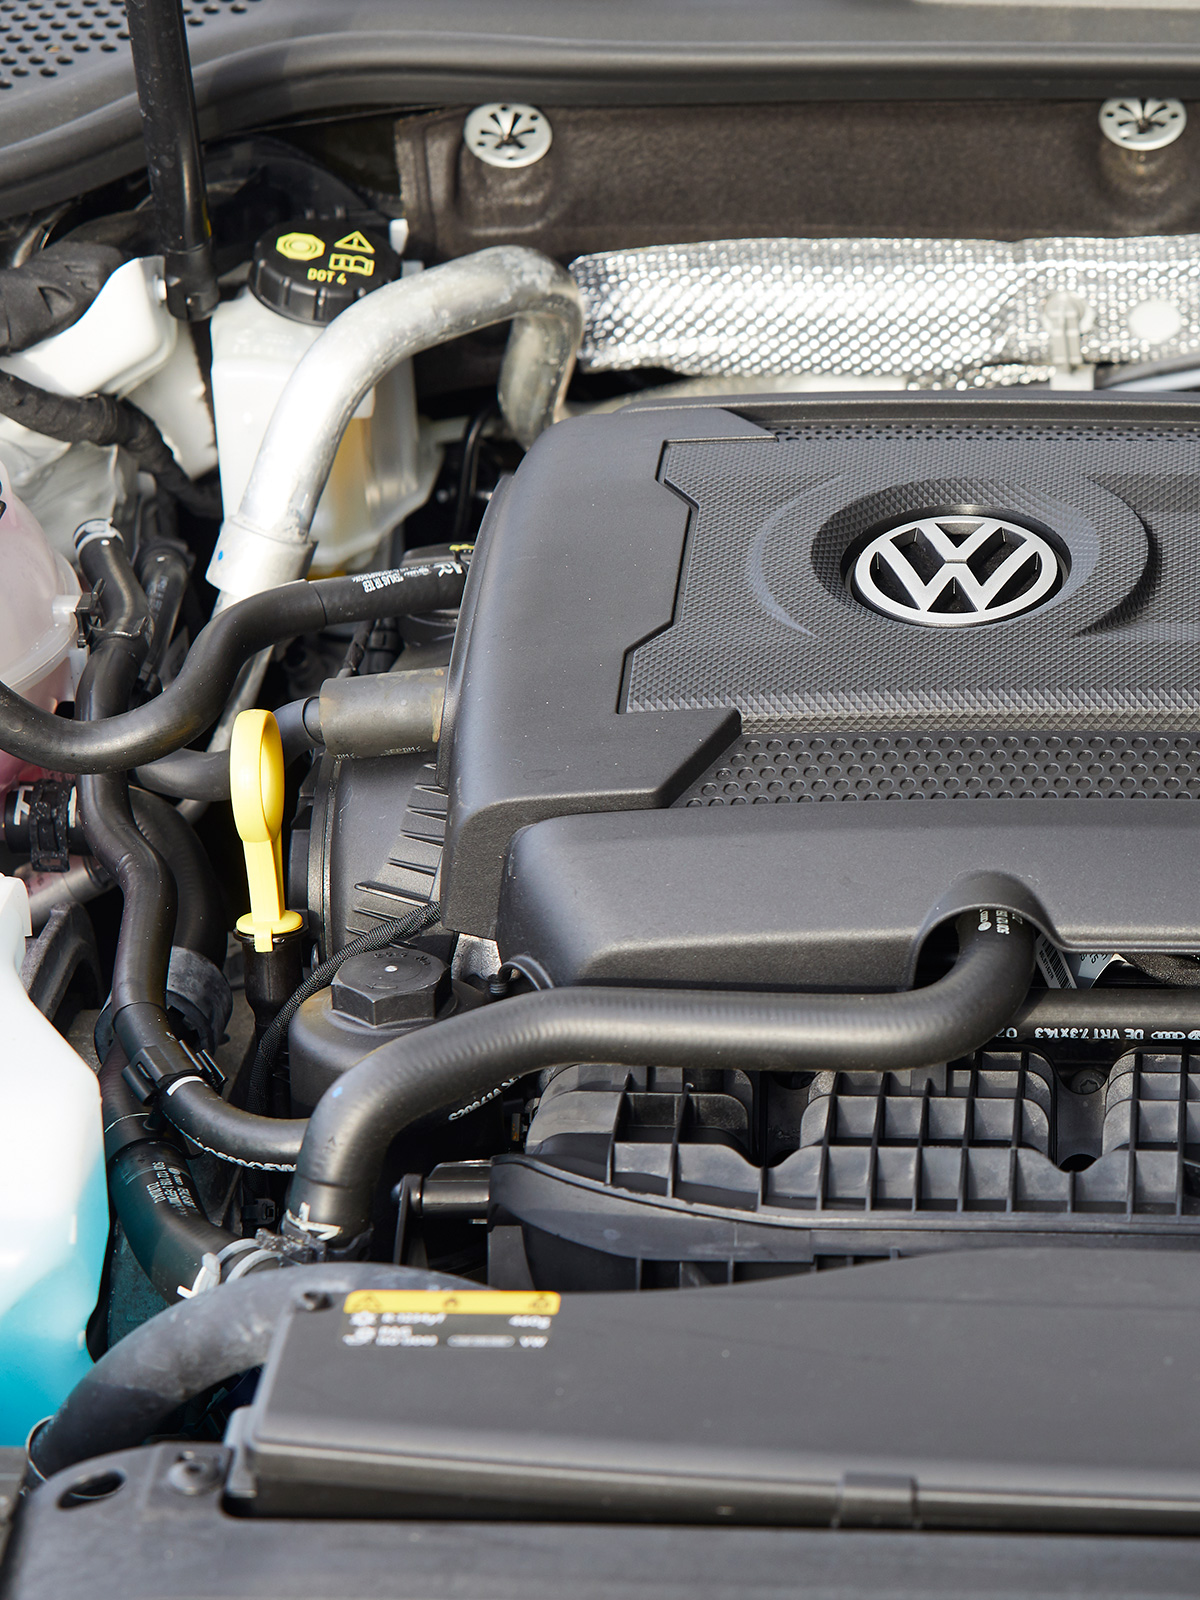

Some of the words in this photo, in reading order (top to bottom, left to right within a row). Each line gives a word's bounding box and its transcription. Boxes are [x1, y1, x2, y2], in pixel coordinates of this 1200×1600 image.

[307, 267, 336, 283] DOT
[336, 272, 347, 286] 4
[1092, 1028, 1121, 1040] VRT
[1124, 1028, 1145, 1040] DE
